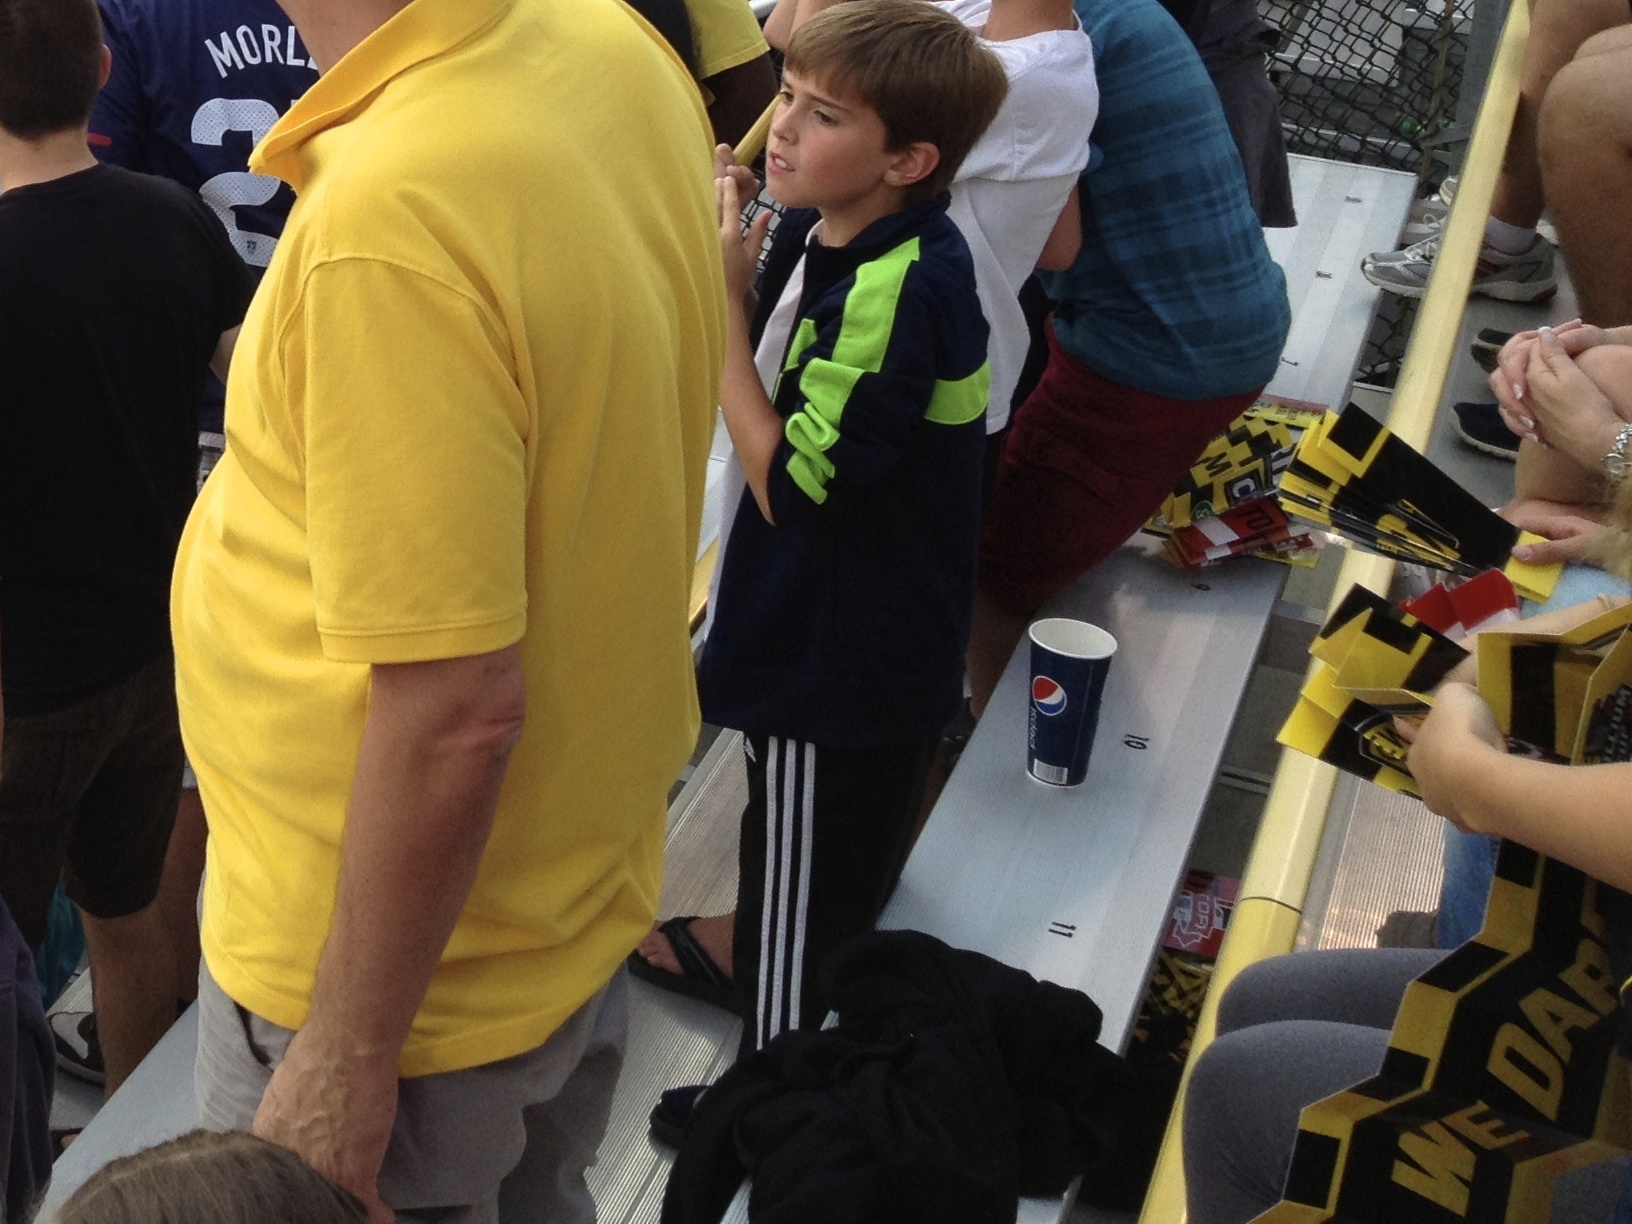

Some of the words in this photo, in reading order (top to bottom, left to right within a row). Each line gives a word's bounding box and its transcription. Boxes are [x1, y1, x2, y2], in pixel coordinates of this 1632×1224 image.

[204, 23, 319, 79] MORL
[1123, 733, 1150, 751] 10
[1048, 921, 1076, 939] 11
[1390, 1098, 1532, 1218] WE
